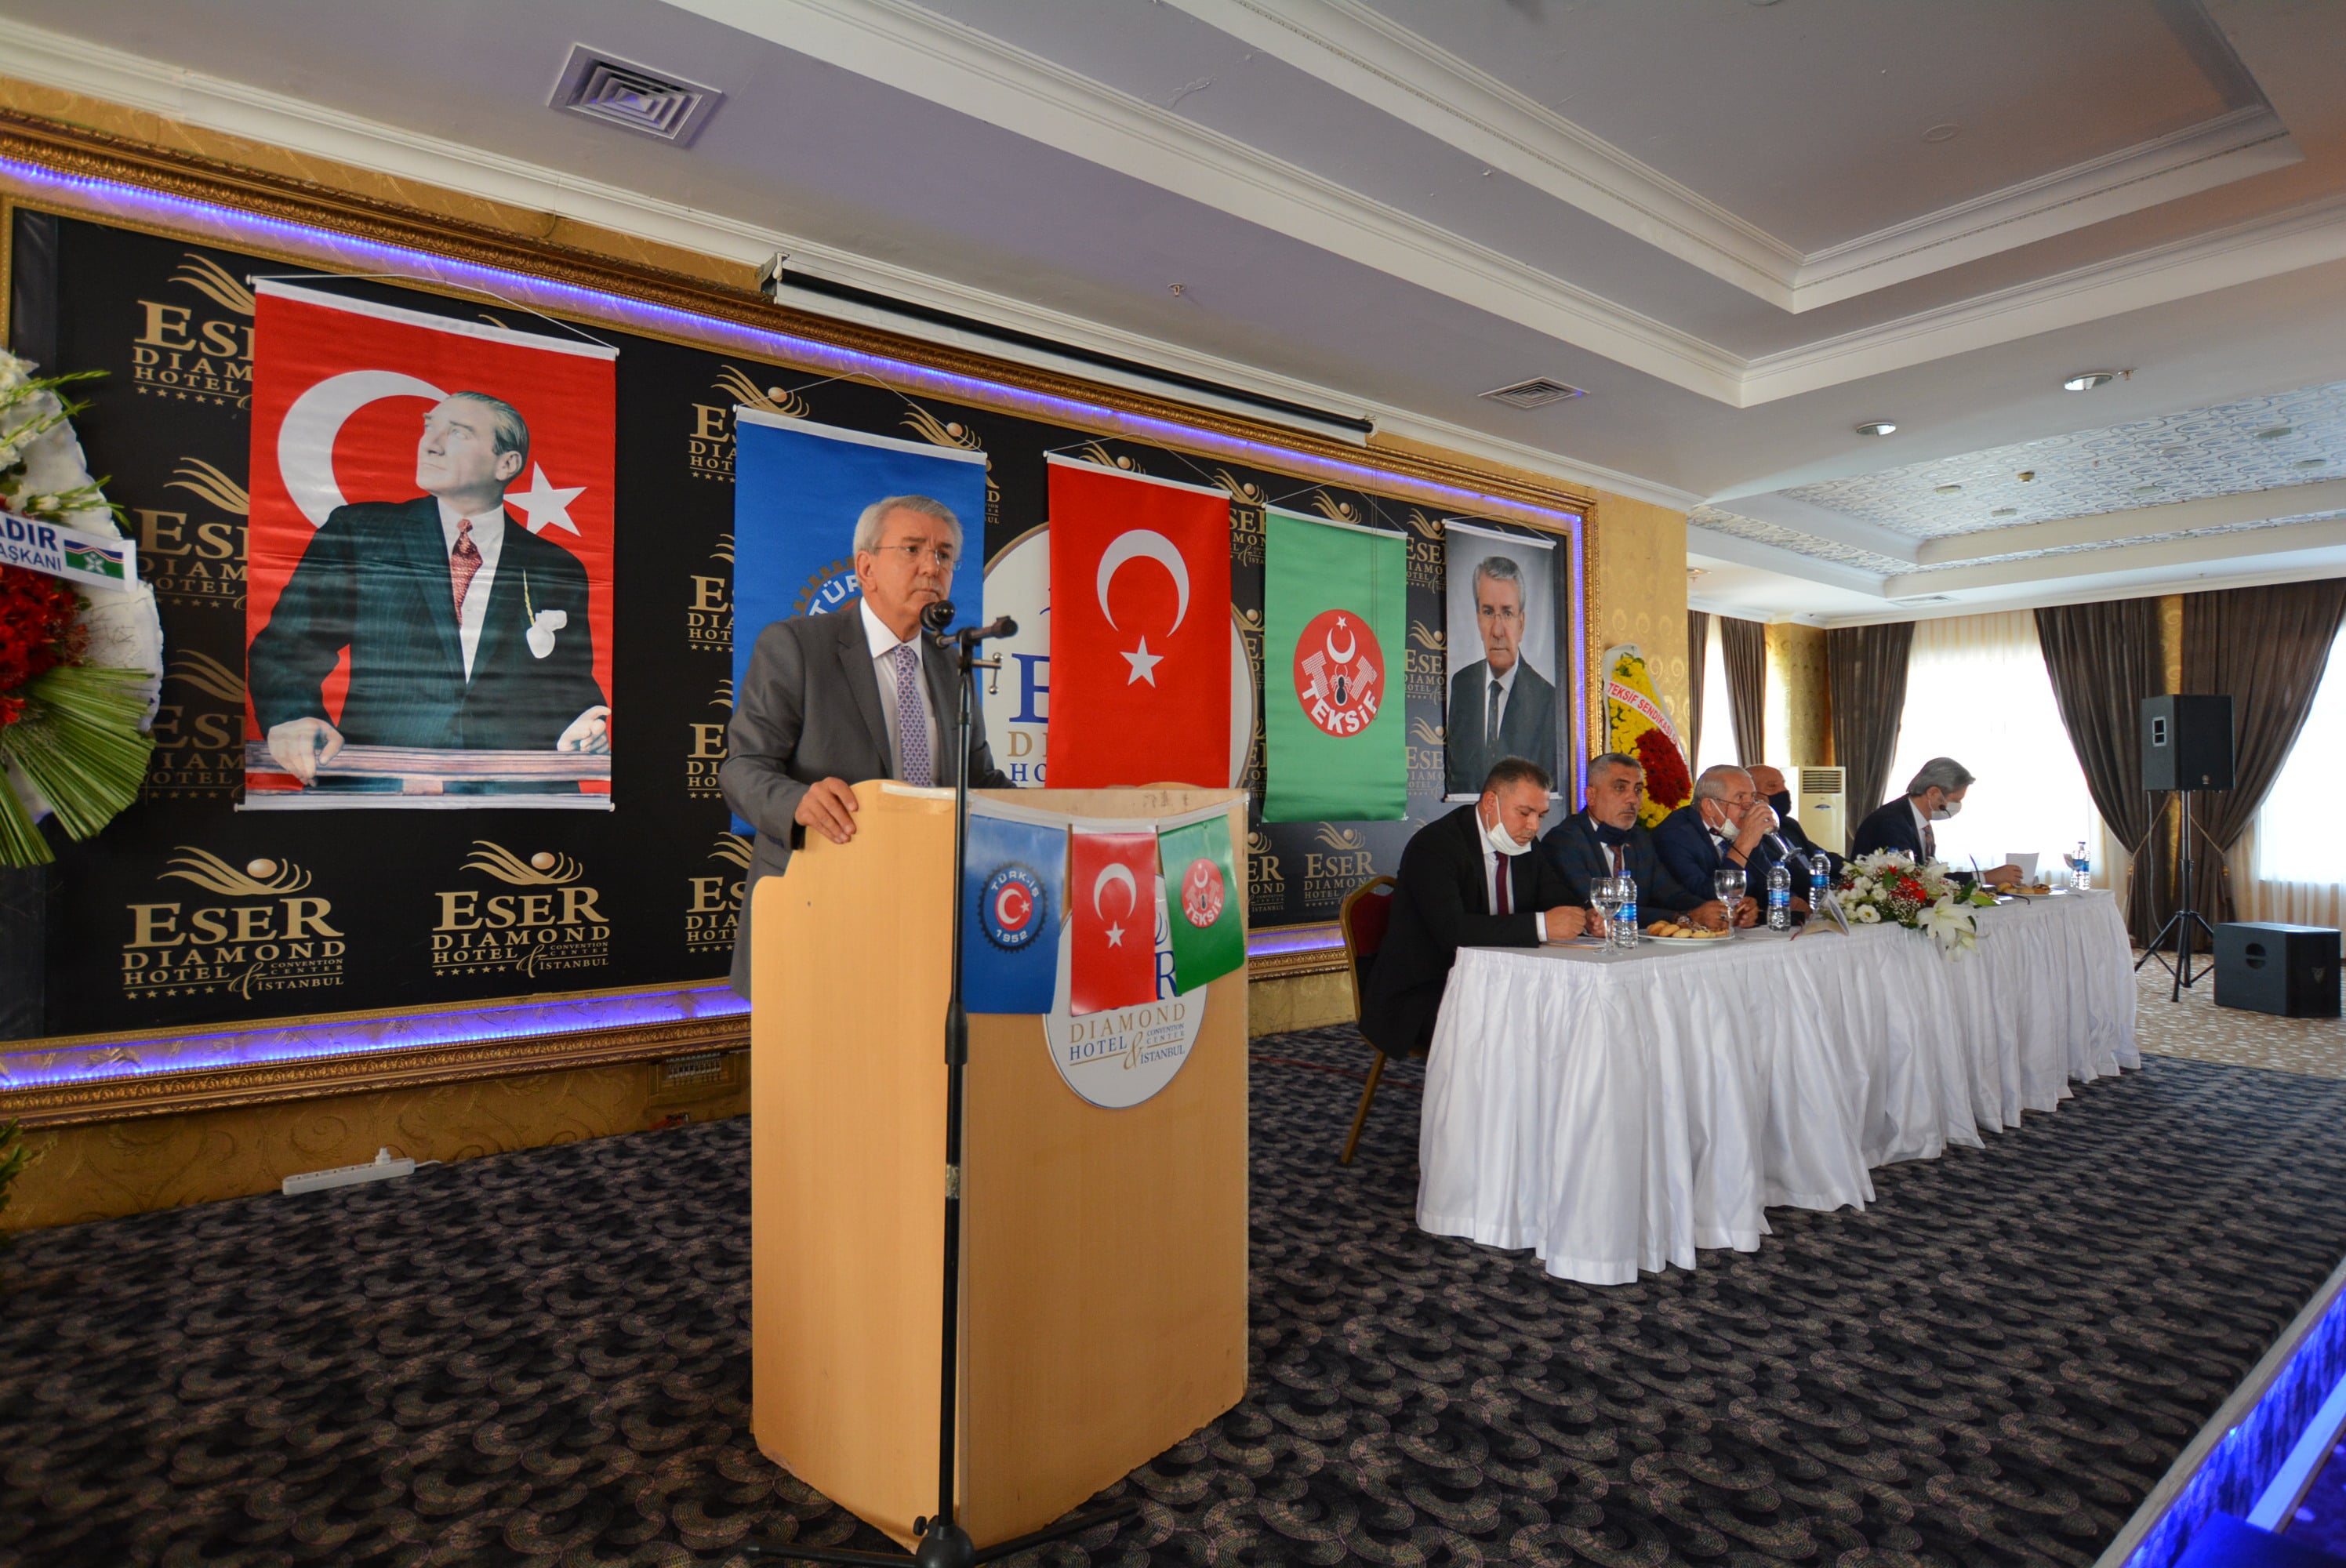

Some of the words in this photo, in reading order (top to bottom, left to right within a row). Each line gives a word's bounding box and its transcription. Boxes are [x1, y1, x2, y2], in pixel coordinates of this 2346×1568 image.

[133, 300, 255, 362] ES
[133, 347, 254, 381] DIAM
[134, 366, 239, 394] HOTEL
[689, 456, 734, 471] HOT
[0, 517, 58, 552] DIR
[133, 508, 249, 561] ES
[141, 577, 235, 595] OTEL
[1406, 571, 1429, 580] OTEL
[808, 575, 858, 616] TÜR
[689, 627, 733, 641] HOT
[1405, 649, 1447, 674] ESE
[1407, 684, 1430, 692] OTEL
[1607, 682, 1639, 704] TEKSİF
[1302, 679, 1378, 735] TEKSİF
[152, 772, 232, 785] OTEL
[1248, 856, 1284, 883] ER
[1305, 851, 1377, 879] ESER
[1305, 890, 1338, 899] HOTEL
[433, 887, 608, 931] ESER
[1186, 895, 1222, 926] TEKSİF
[123, 897, 345, 949] ESER
[687, 929, 738, 942] HOT
[997, 929, 1028, 942] 1952
[431, 926, 610, 950] DIAMOND
[550, 942, 608, 950] CONVENTION
[122, 941, 346, 970] DIAMOND
[271, 959, 343, 968] CONVENTION
[433, 947, 518, 964] HOTEL
[550, 947, 608, 956] CENTER
[124, 964, 231, 985] HOTEL
[271, 965, 343, 975] CENTER
[1070, 1003, 1186, 1044] DIAMOND
[1070, 1036, 1128, 1062] HOTEL
